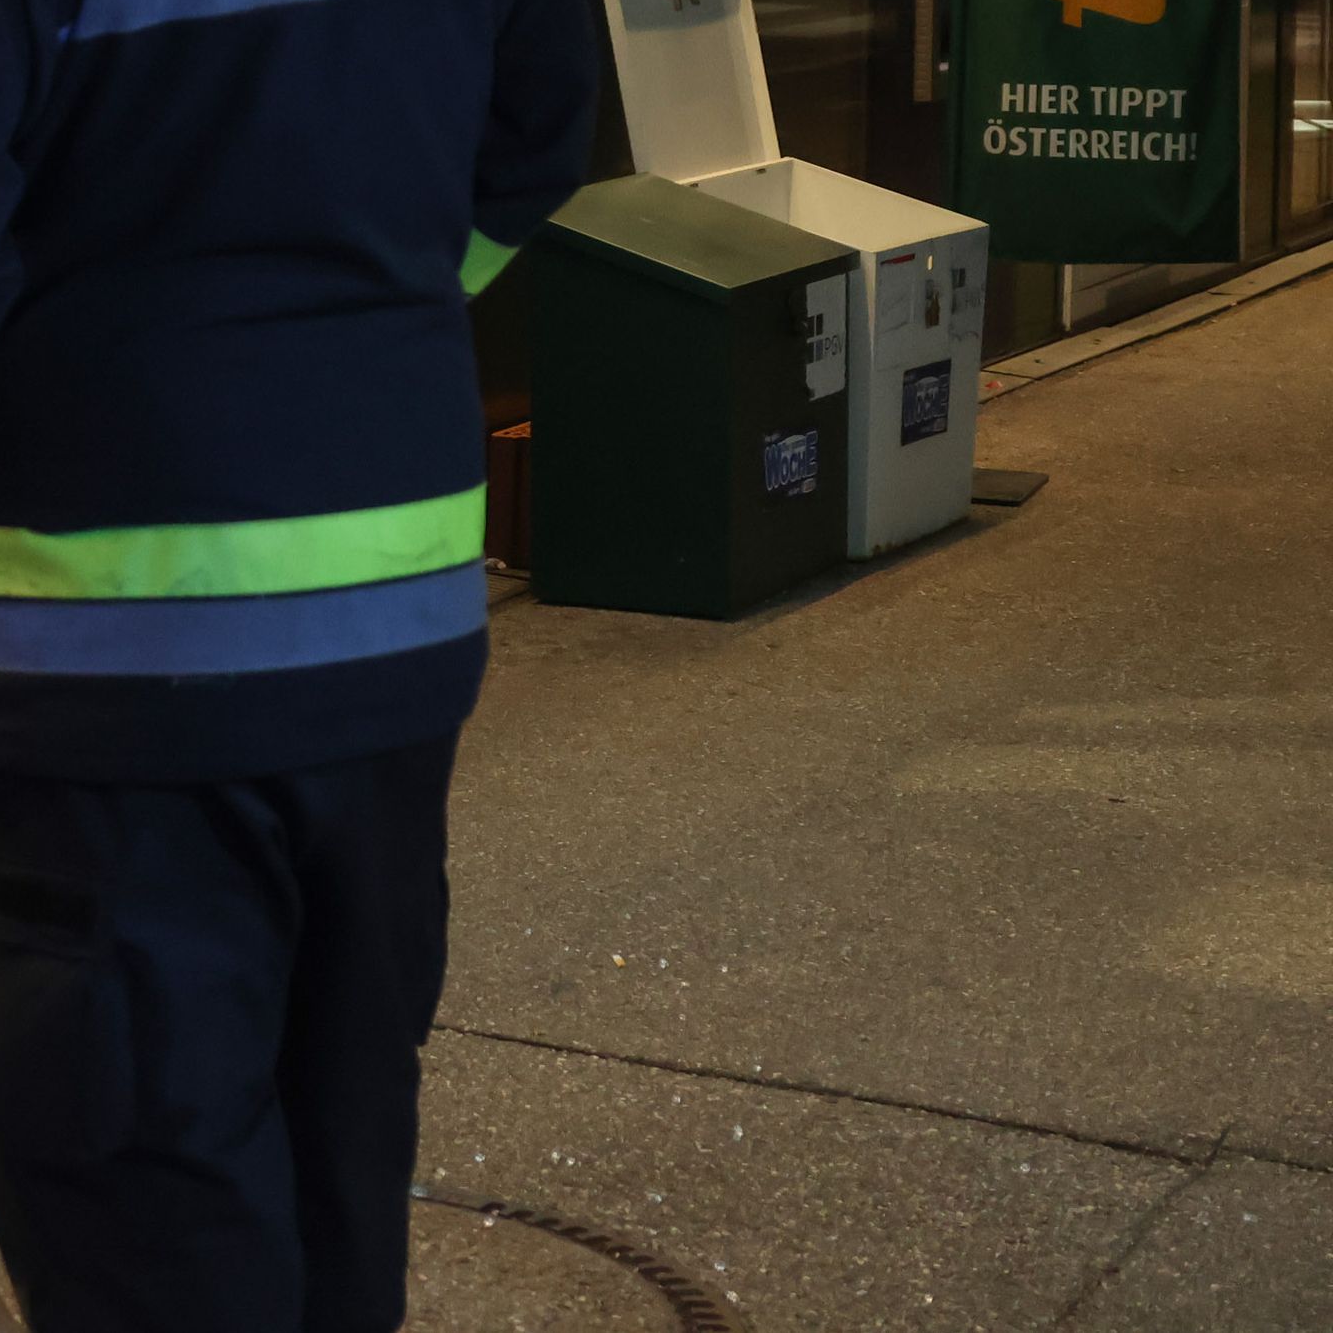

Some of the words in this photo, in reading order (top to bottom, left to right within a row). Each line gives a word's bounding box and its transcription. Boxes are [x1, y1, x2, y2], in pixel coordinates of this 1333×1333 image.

[1001, 82, 1080, 115] HIER
[1090, 85, 1187, 119] TIPPT
[983, 118, 1198, 162] ÖSTERREICH!
